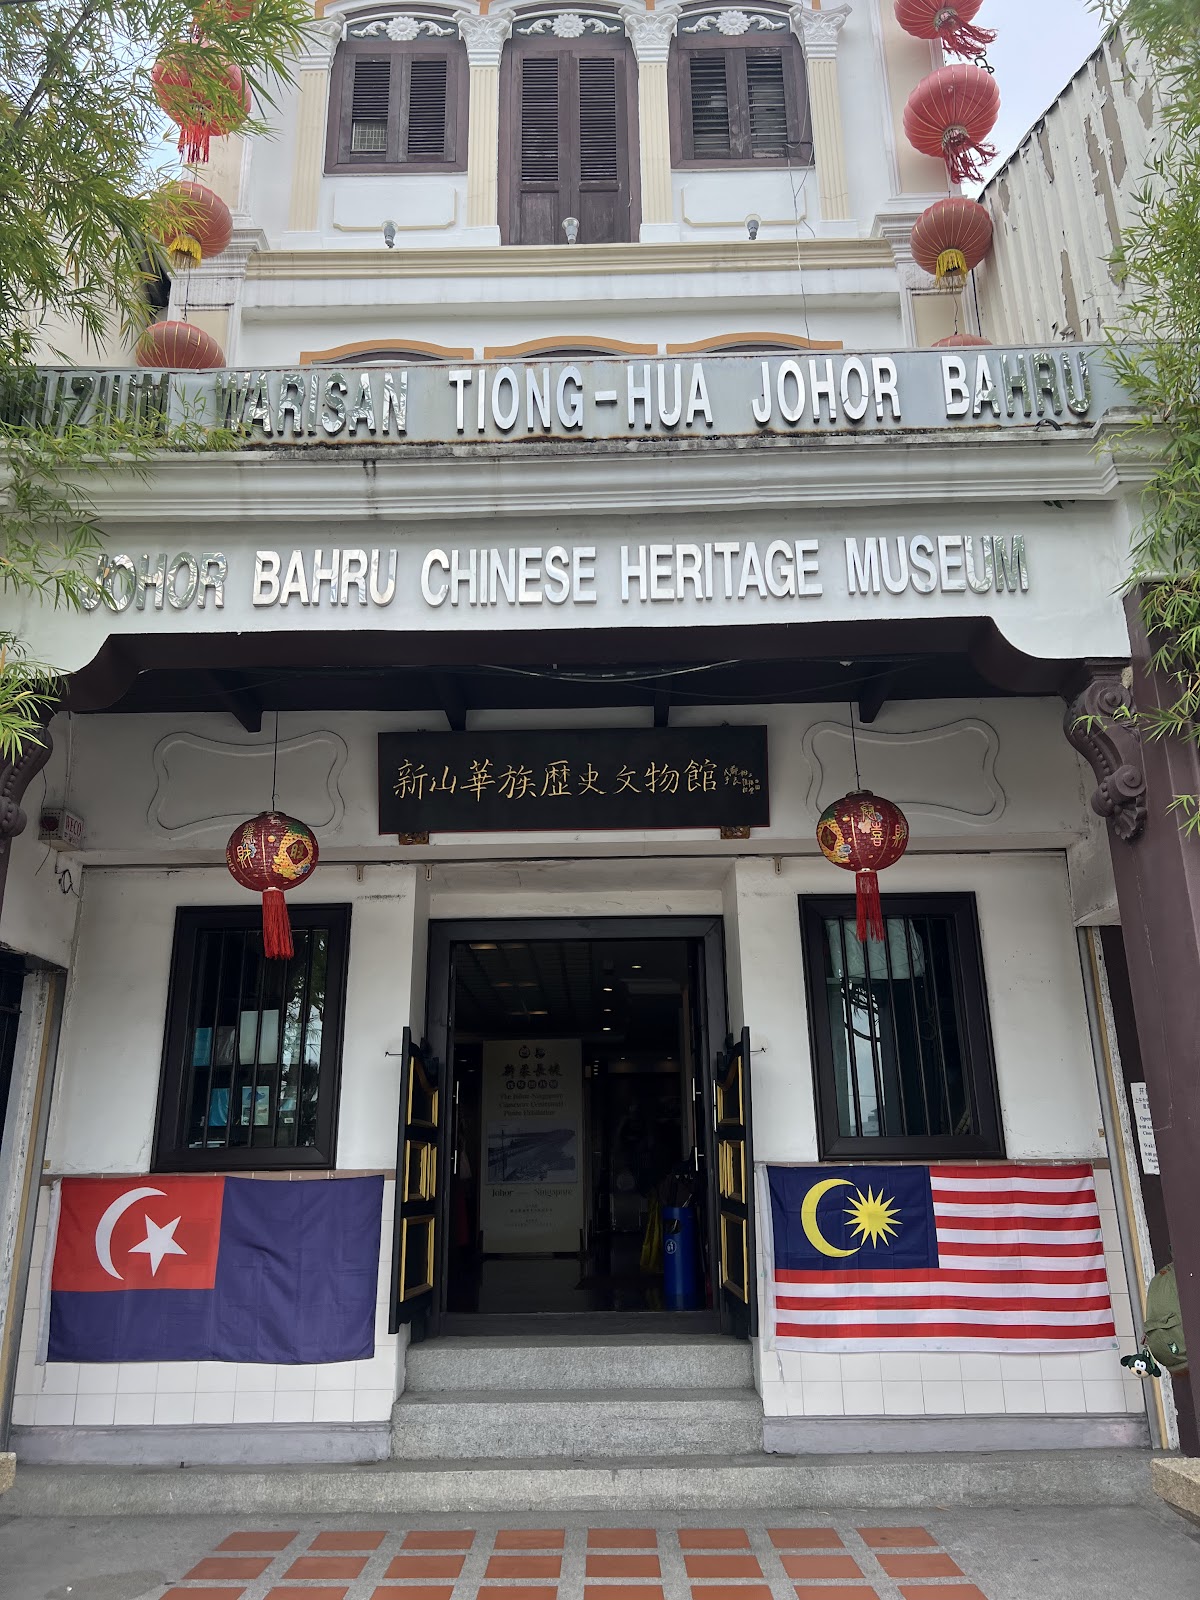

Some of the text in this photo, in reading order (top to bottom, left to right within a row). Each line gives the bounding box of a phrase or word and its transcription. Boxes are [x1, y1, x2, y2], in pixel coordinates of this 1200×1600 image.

[0, 351, 1092, 441] UZIUM WARISAN TIONG-HUA JOHOR BAHRU
[79, 534, 1030, 612] JOHOR BAHRU CHINESE HERITAGE MUSEUM
